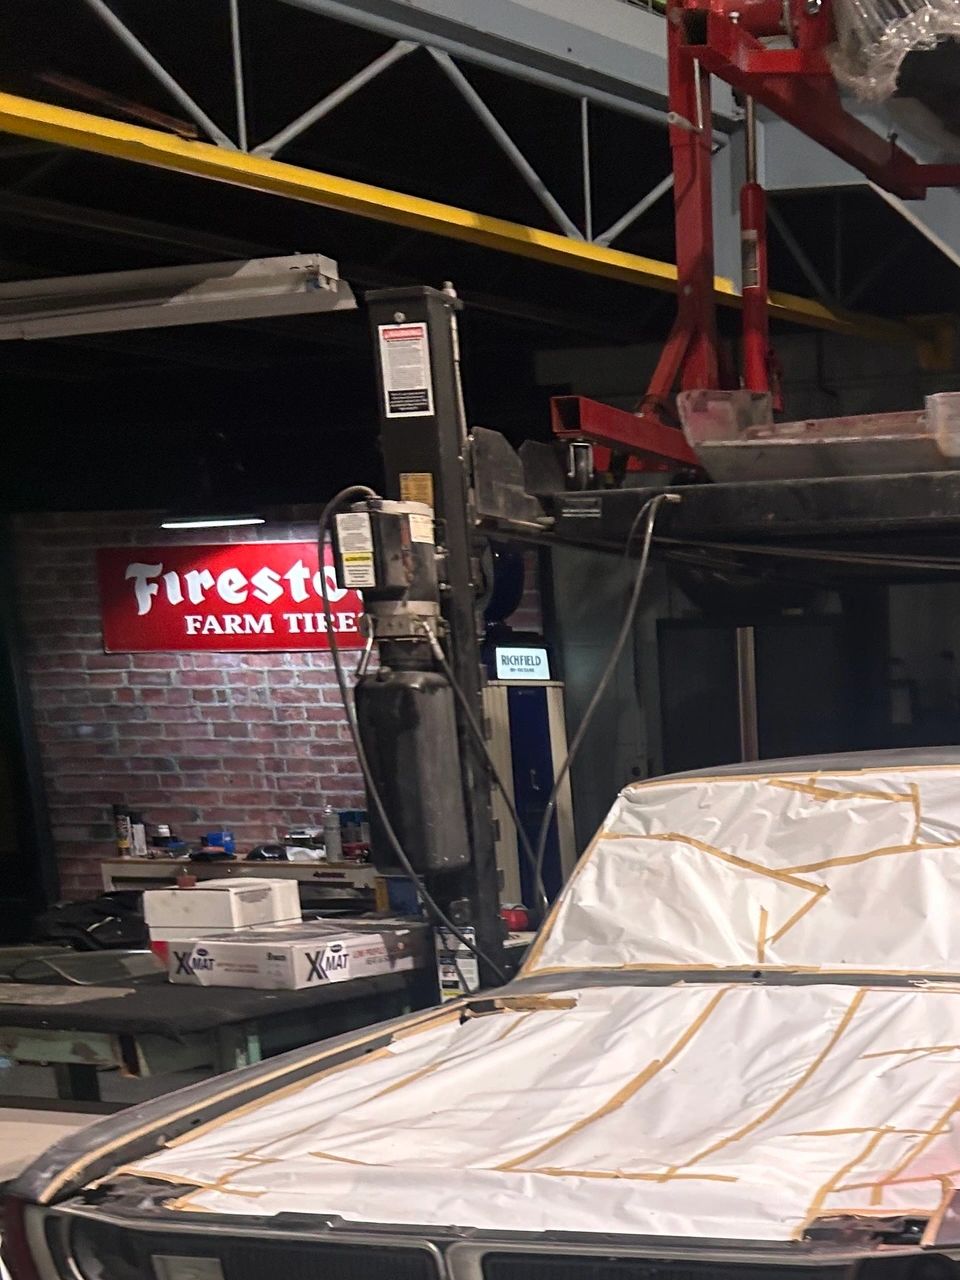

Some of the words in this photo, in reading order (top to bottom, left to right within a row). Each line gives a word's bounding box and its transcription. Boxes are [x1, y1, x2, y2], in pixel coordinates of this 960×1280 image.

[124, 558, 364, 617] Firesto
[184, 613, 274, 635] FARM
[282, 611, 364, 634] TIRE
[500, 654, 542, 667] RICHFIELD
